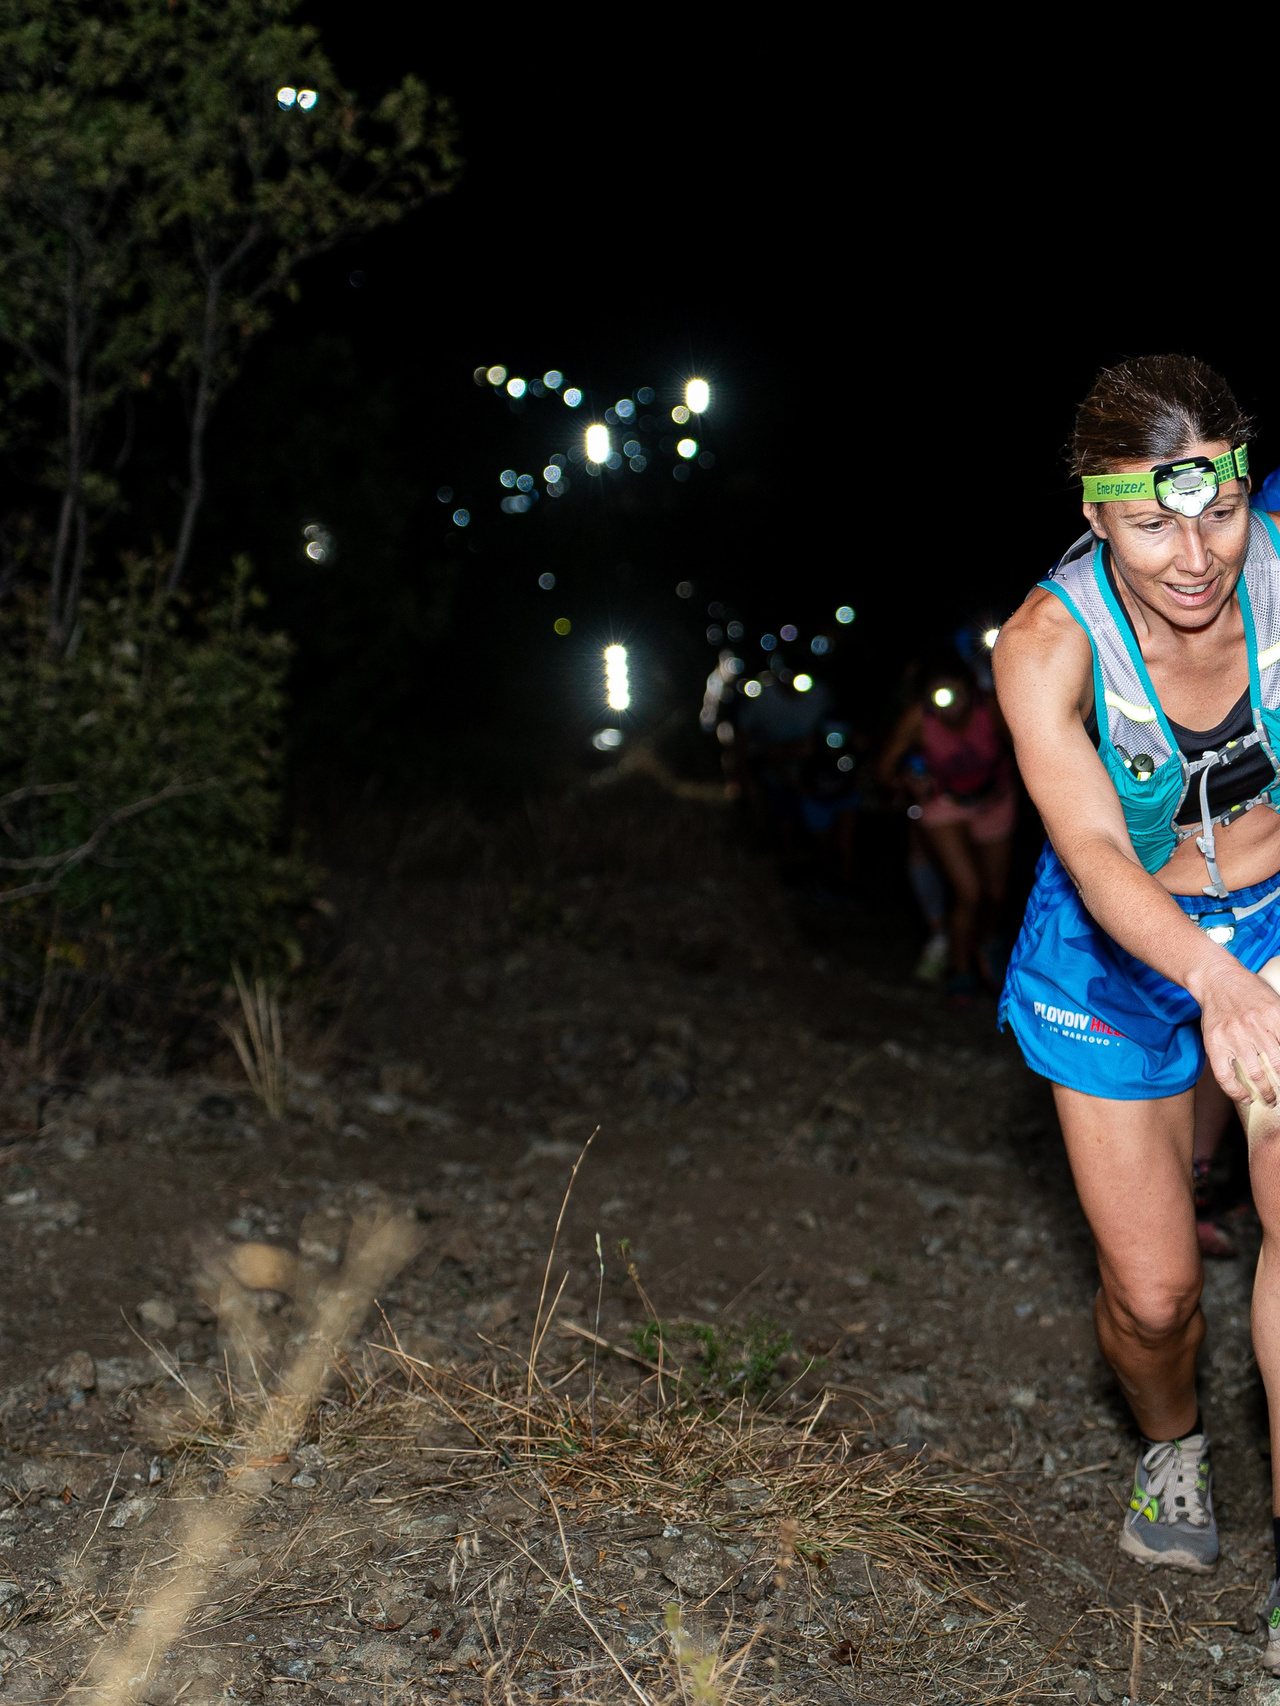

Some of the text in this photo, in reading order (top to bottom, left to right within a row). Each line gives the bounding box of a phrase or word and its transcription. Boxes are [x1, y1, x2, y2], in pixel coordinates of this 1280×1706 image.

[1033, 1001, 1090, 1031] PLOVDIV
[1049, 1025, 1110, 1047] IN MARKOVO
